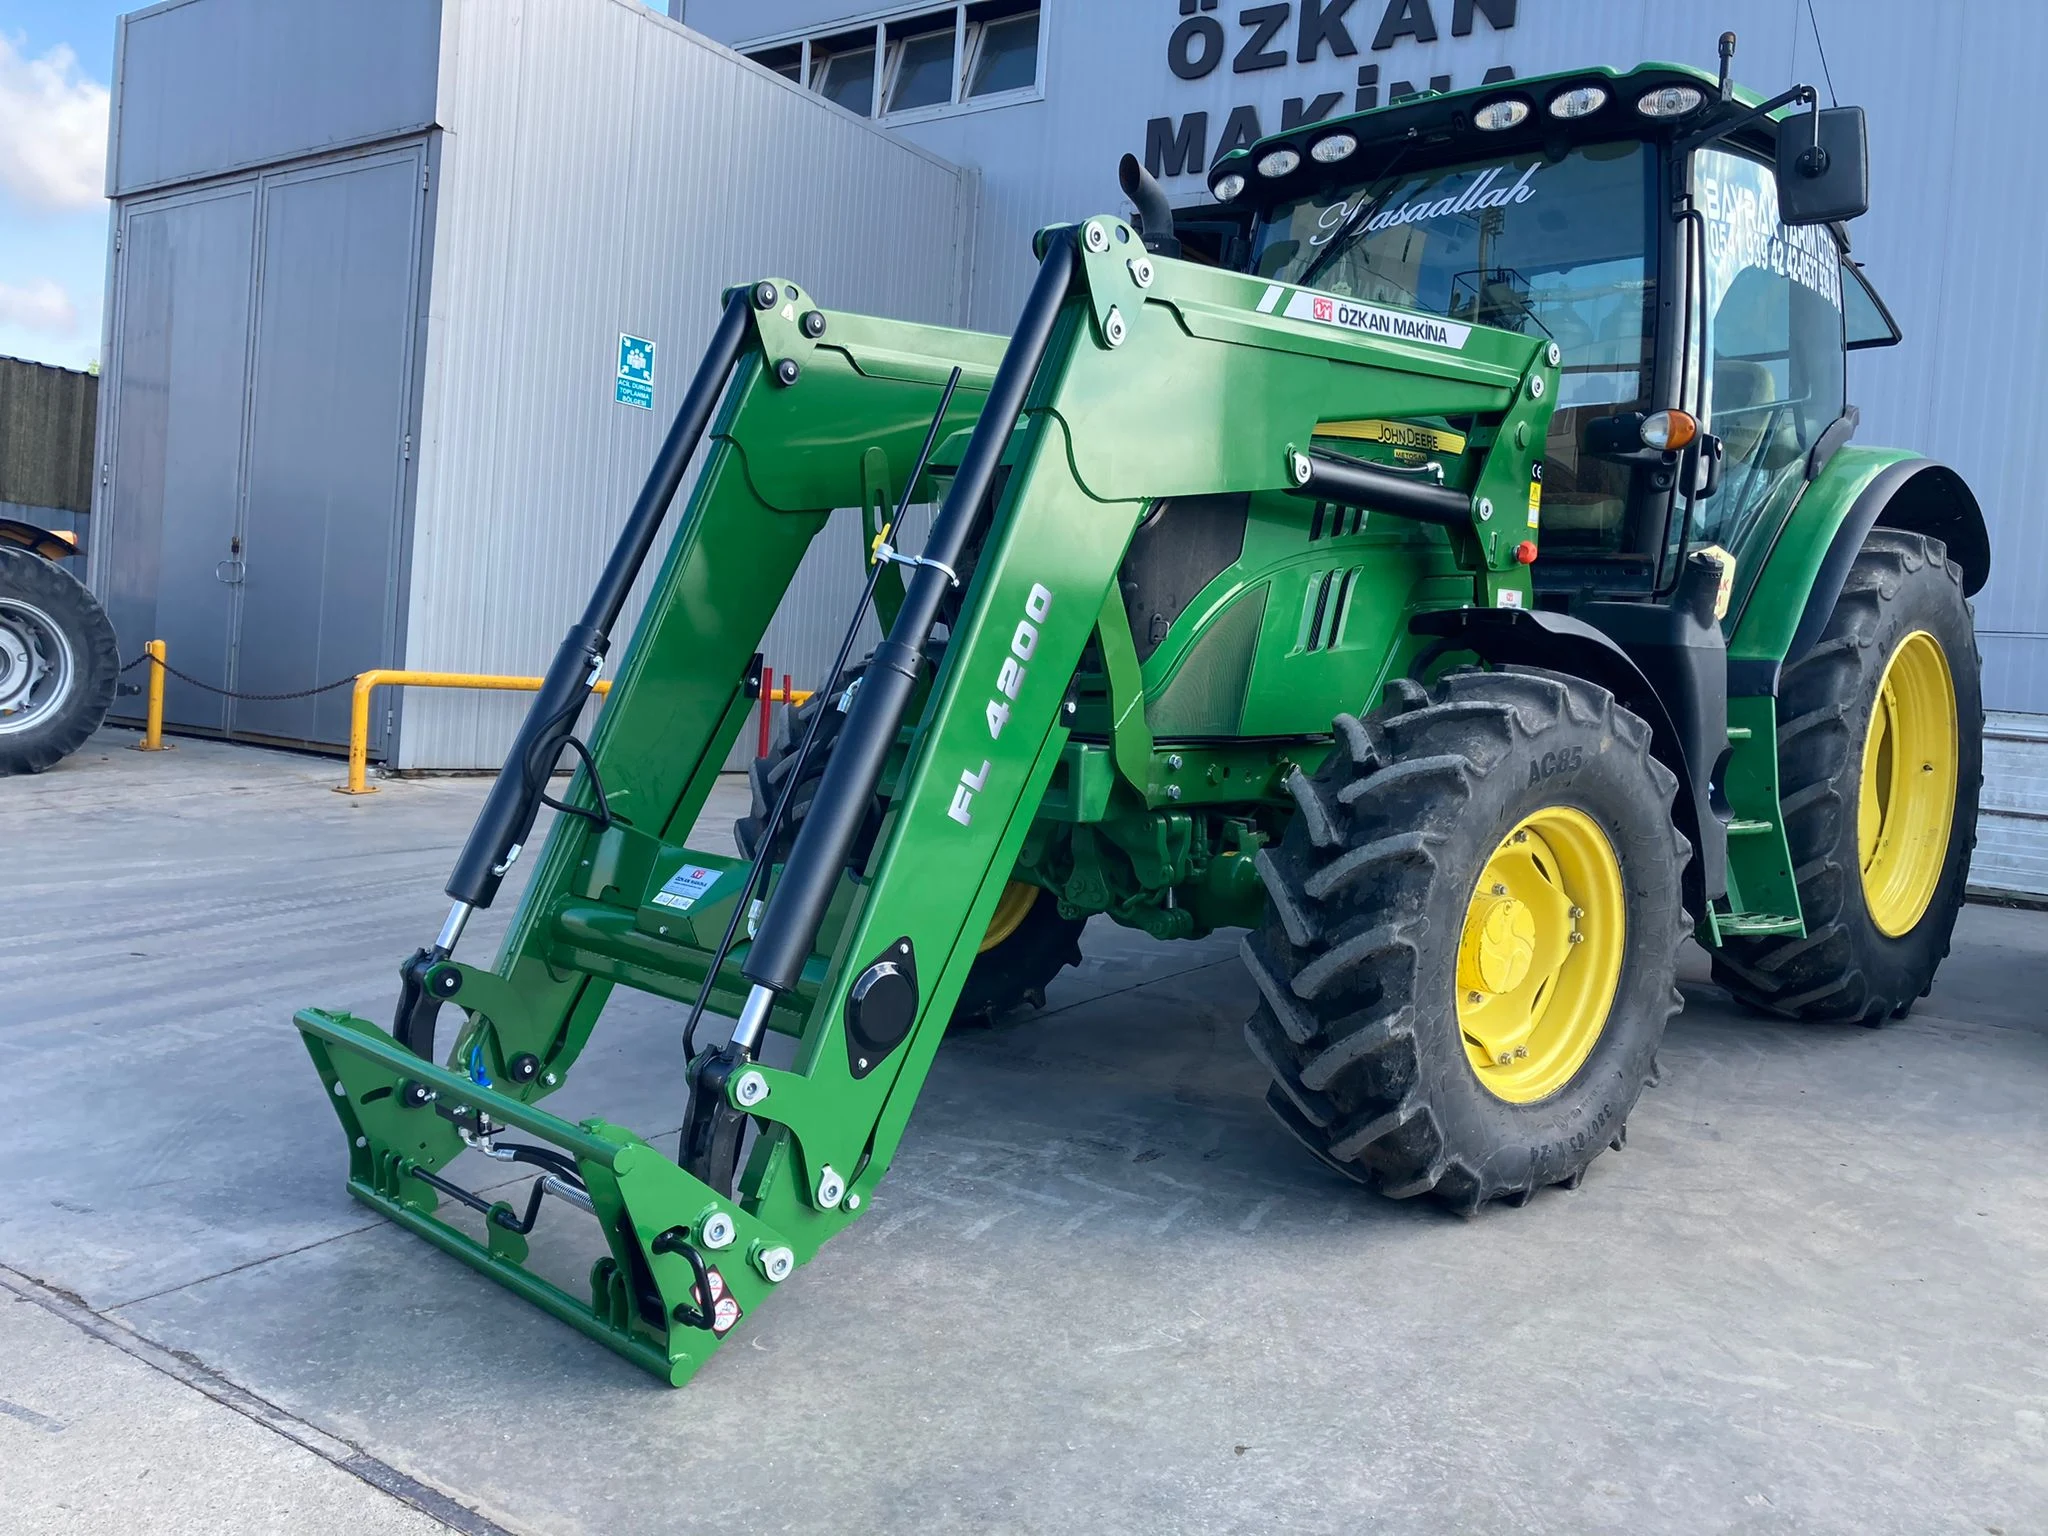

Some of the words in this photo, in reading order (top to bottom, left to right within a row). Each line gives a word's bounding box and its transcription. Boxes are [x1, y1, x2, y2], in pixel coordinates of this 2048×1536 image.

[1167, 0, 1516, 80] ÖZKAN
[1705, 178, 1779, 239] BAYRAK
[1745, 230, 1769, 271] 939
[1770, 238, 1785, 276] 42
[1337, 303, 1391, 334] ÖZKAN
[1392, 317, 1448, 345] MAKİNA
[619, 387, 650, 400] TOPLANMA
[631, 382, 652, 392] DURUM
[1377, 423, 1407, 445] JOHN
[1406, 427, 1439, 450] DEERE
[947, 759, 992, 828] FL
[985, 582, 1053, 741] 4200
